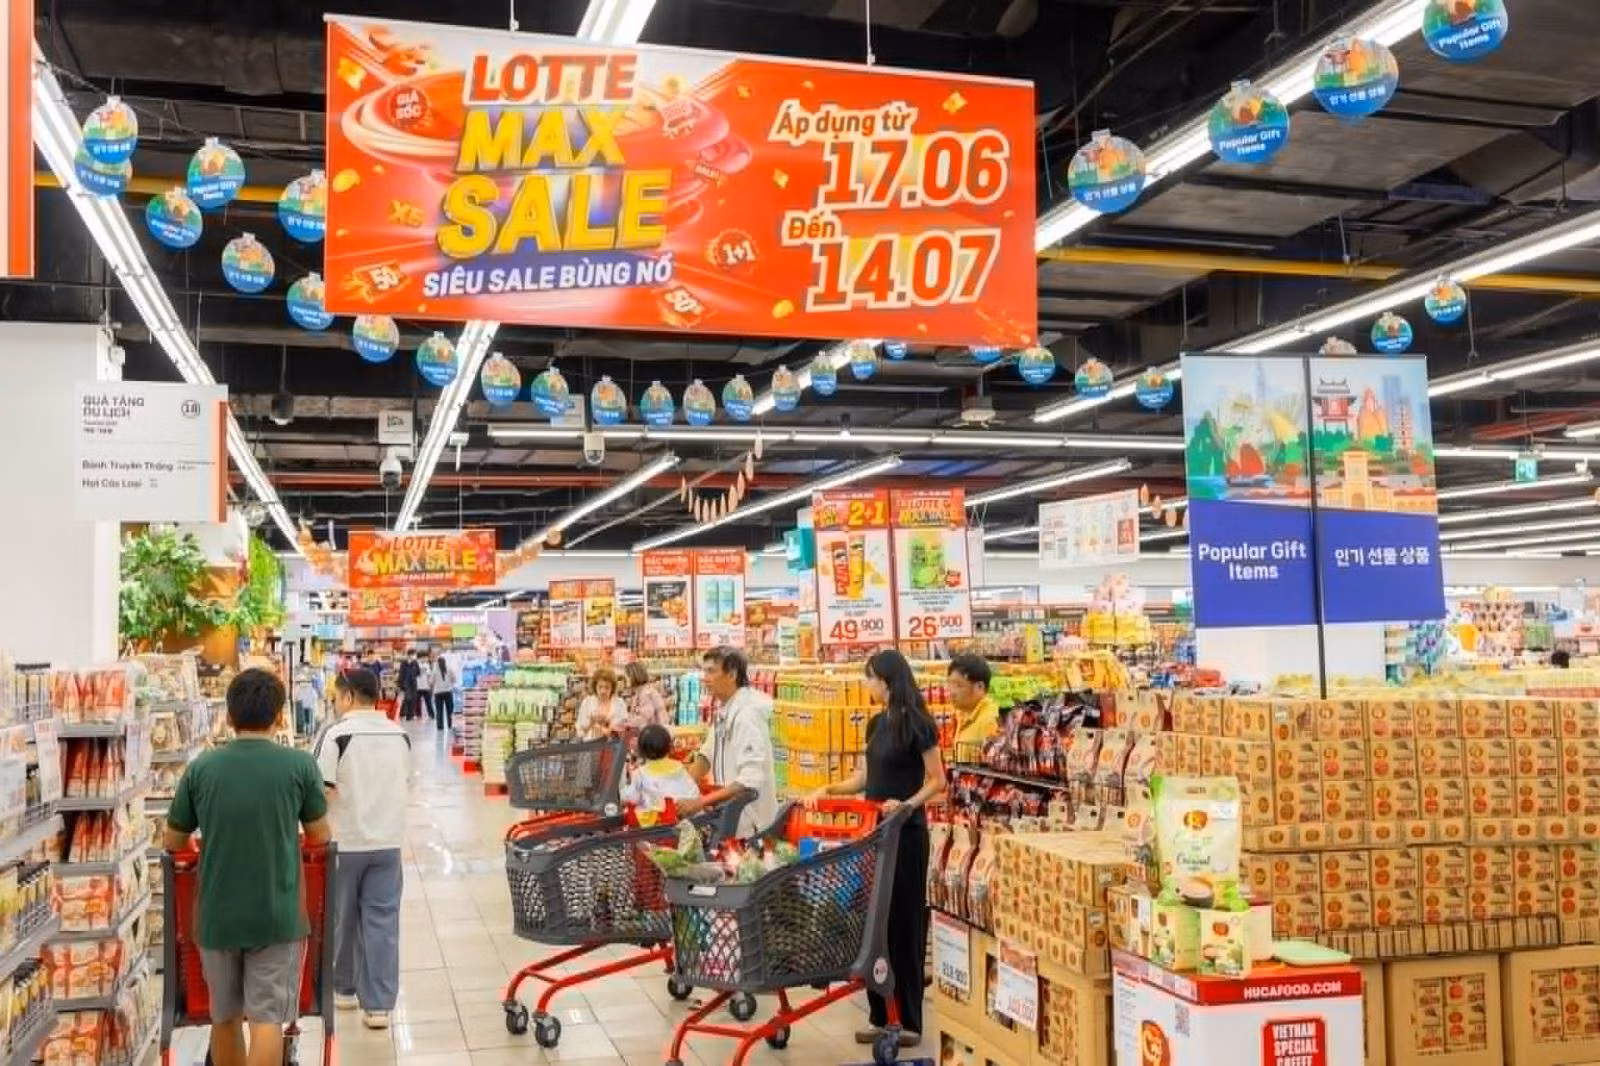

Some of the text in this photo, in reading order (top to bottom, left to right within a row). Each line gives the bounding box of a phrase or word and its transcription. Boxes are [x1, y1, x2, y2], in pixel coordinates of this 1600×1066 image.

[1439, 26, 1479, 47] Popular
[466, 50, 638, 104] LOTTE
[777, 104, 911, 140] Áp dụng từ
[456, 106, 625, 171] MAX
[1220, 129, 1281, 150] Popular Gift
[820, 131, 1008, 207] 17.06
[436, 170, 671, 259] SALE
[788, 210, 836, 239] Đến
[722, 240, 756, 265] 1+1
[424, 266, 483, 297] SIÊU
[489, 264, 555, 291] SALE
[560, 258, 630, 288] BÙNG
[808, 230, 998, 311] 14.07
[850, 500, 884, 525] 2+1
[392, 535, 446, 551] LOTTE
[1198, 540, 1307, 565] Popular Gift
[373, 547, 477, 574] MAX SALE
[1335, 549, 1364, 567] 인기
[1368, 548, 1397, 566] 선물
[1229, 562, 1279, 580] Items
[1244, 981, 1342, 999] HUCAFOOD.COM
[1272, 1021, 1317, 1039] VIETNAM
[1274, 1038, 1319, 1057] SPECIAL
